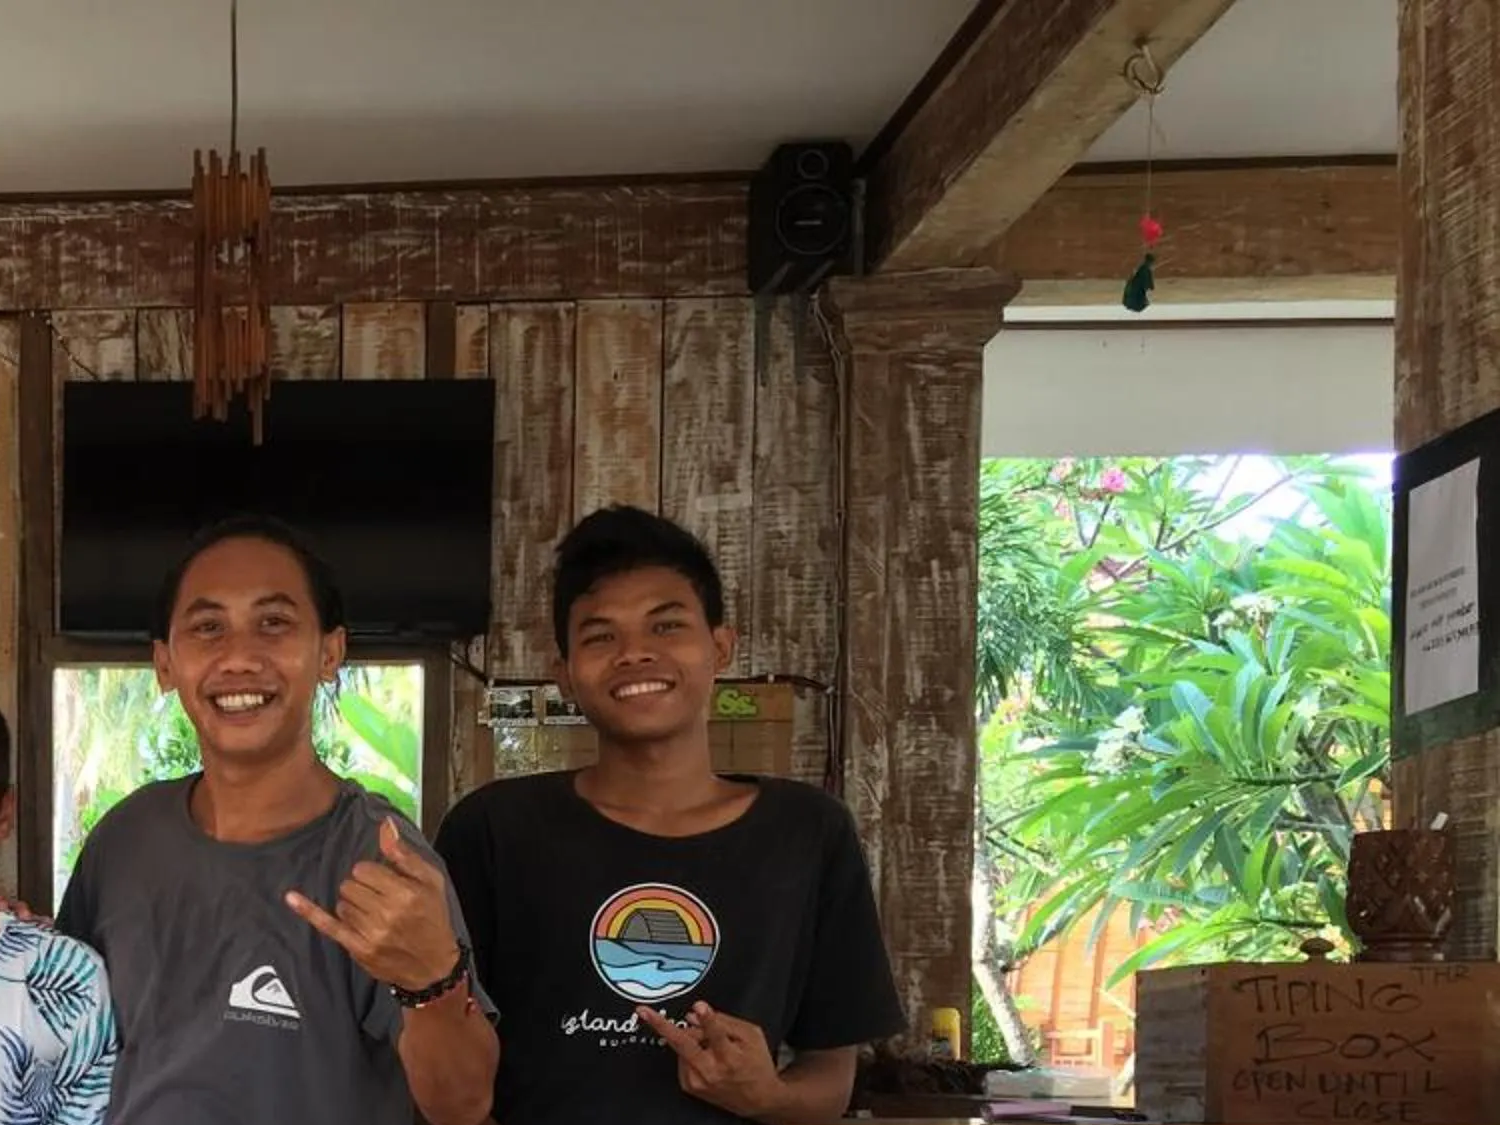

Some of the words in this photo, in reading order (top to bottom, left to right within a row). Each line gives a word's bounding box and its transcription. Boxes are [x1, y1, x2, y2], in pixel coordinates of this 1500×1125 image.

[1252, 1022, 1437, 1066] BOX
[1233, 1066, 1307, 1102] OPEN
[1319, 1069, 1447, 1096] UNTIL
[1295, 1096, 1423, 1123] CLOSE
